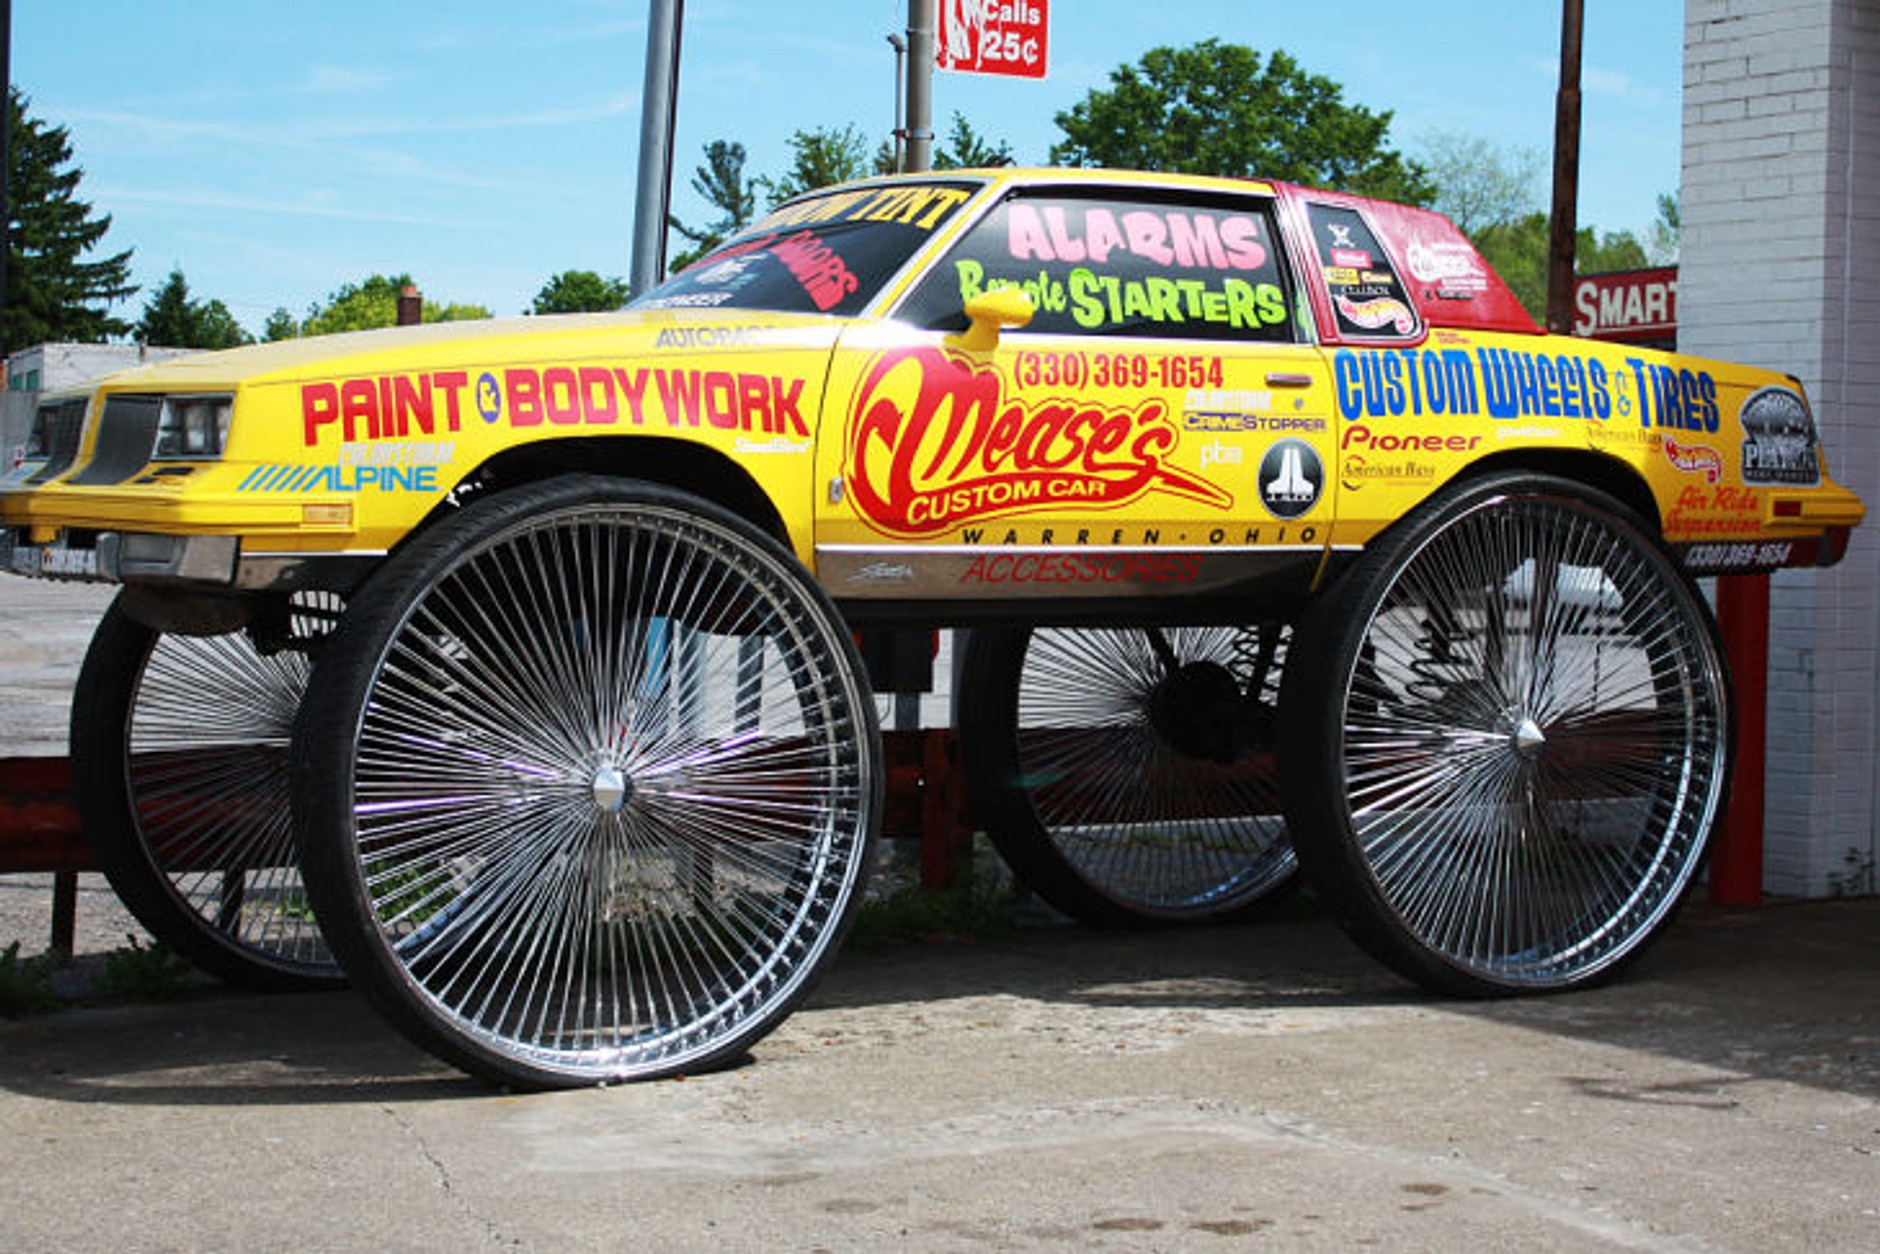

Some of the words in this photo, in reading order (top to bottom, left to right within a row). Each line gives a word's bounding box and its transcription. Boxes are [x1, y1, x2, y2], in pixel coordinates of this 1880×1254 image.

[983, 0, 1040, 25] Calls
[983, 30, 1039, 66] 25¢
[846, 186, 971, 229] TINT
[1007, 203, 1267, 270] ALARMS
[1069, 268, 1287, 328] STARTERS
[301, 371, 468, 447] PAINT
[1334, 348, 1478, 421] CUSTOM
[1477, 347, 1611, 420] WHEELS
[1626, 356, 1720, 433] TIRES
[1341, 424, 1482, 451] Pioneer
[301, 466, 438, 491] ALPINE
[907, 480, 1042, 526] CUSTOM
[1046, 479, 1106, 498] CAR
[962, 527, 1160, 546] WARREN
[1208, 526, 1317, 546] OHIO
[960, 552, 1204, 584] ACCESSORIES
